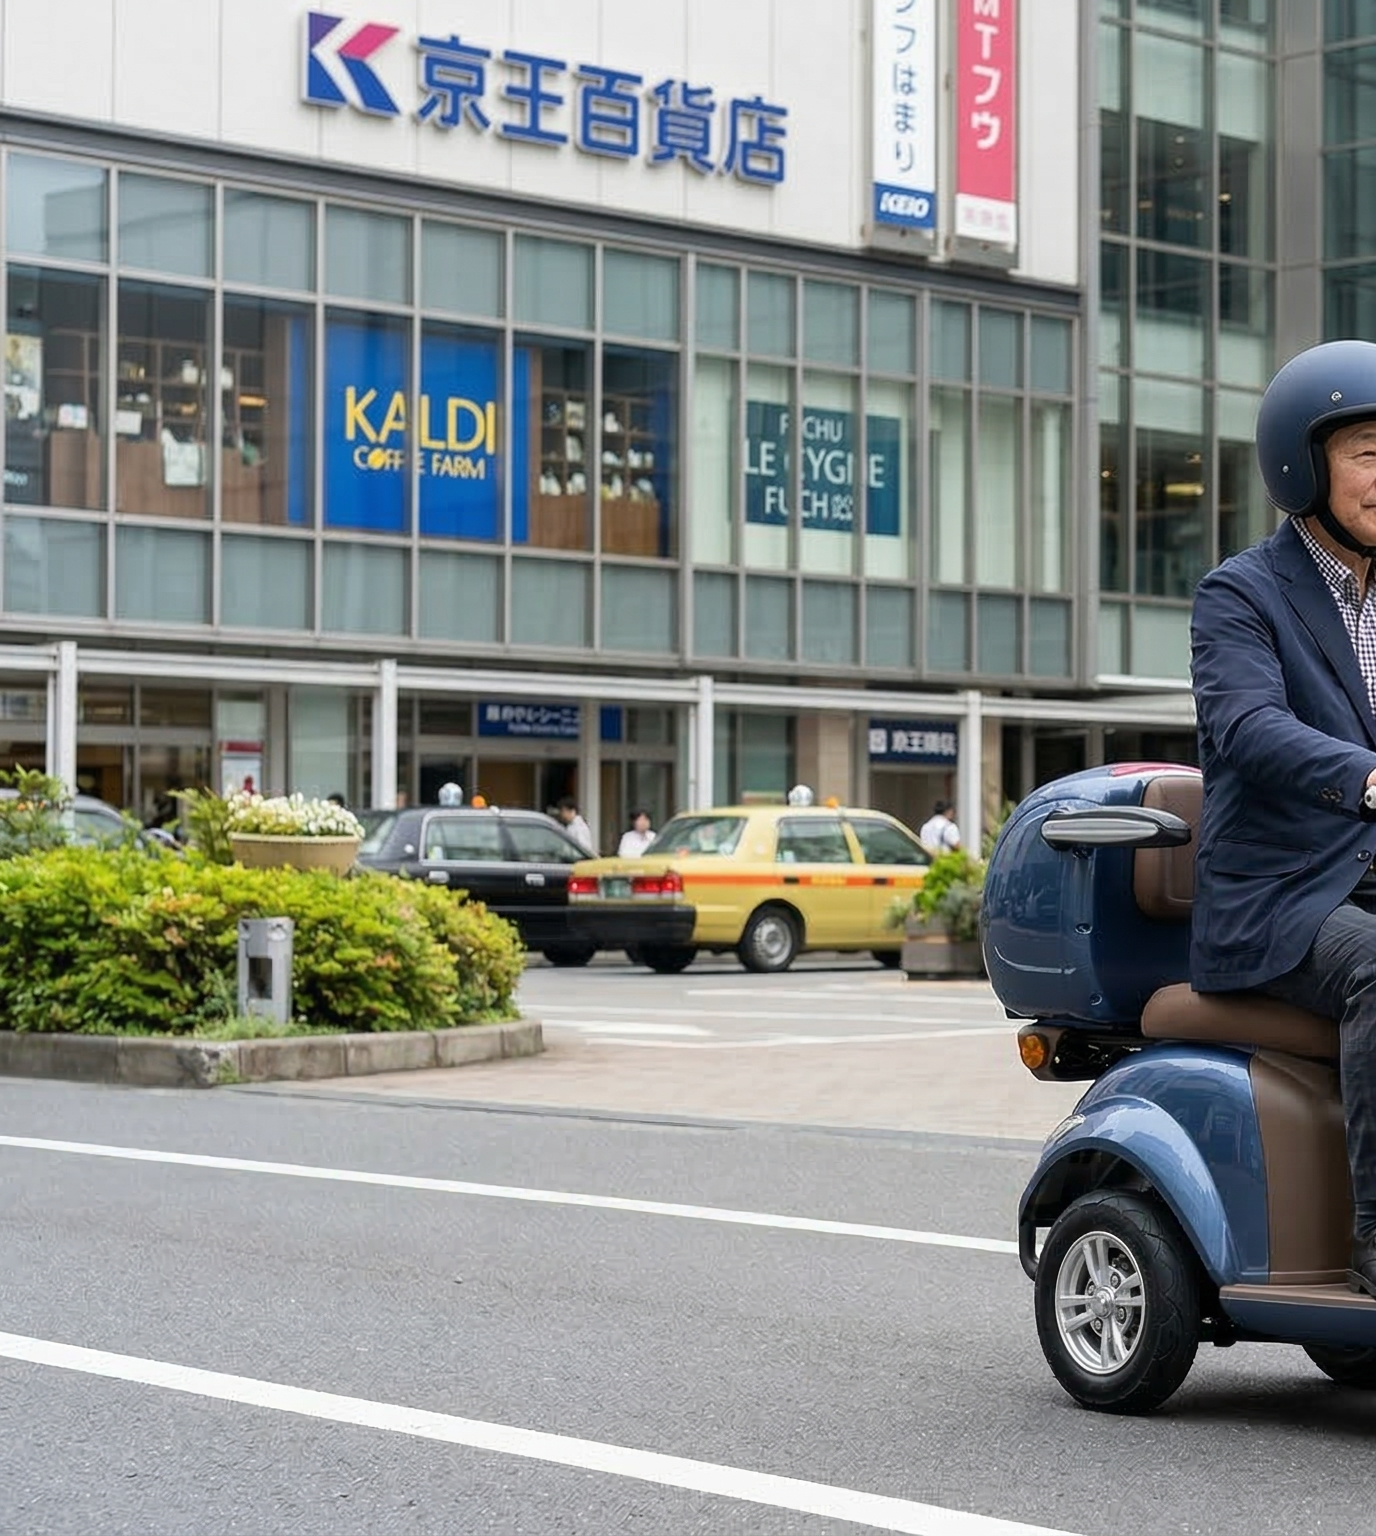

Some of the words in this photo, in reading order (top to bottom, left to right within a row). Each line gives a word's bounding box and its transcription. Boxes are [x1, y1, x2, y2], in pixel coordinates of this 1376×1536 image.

[416, 34, 788, 184] 京王百貨店
[345, 385, 496, 456] KALDI
[779, 412, 844, 443] FCHU
[431, 453, 486, 481] FARM
[743, 437, 777, 477] LE
